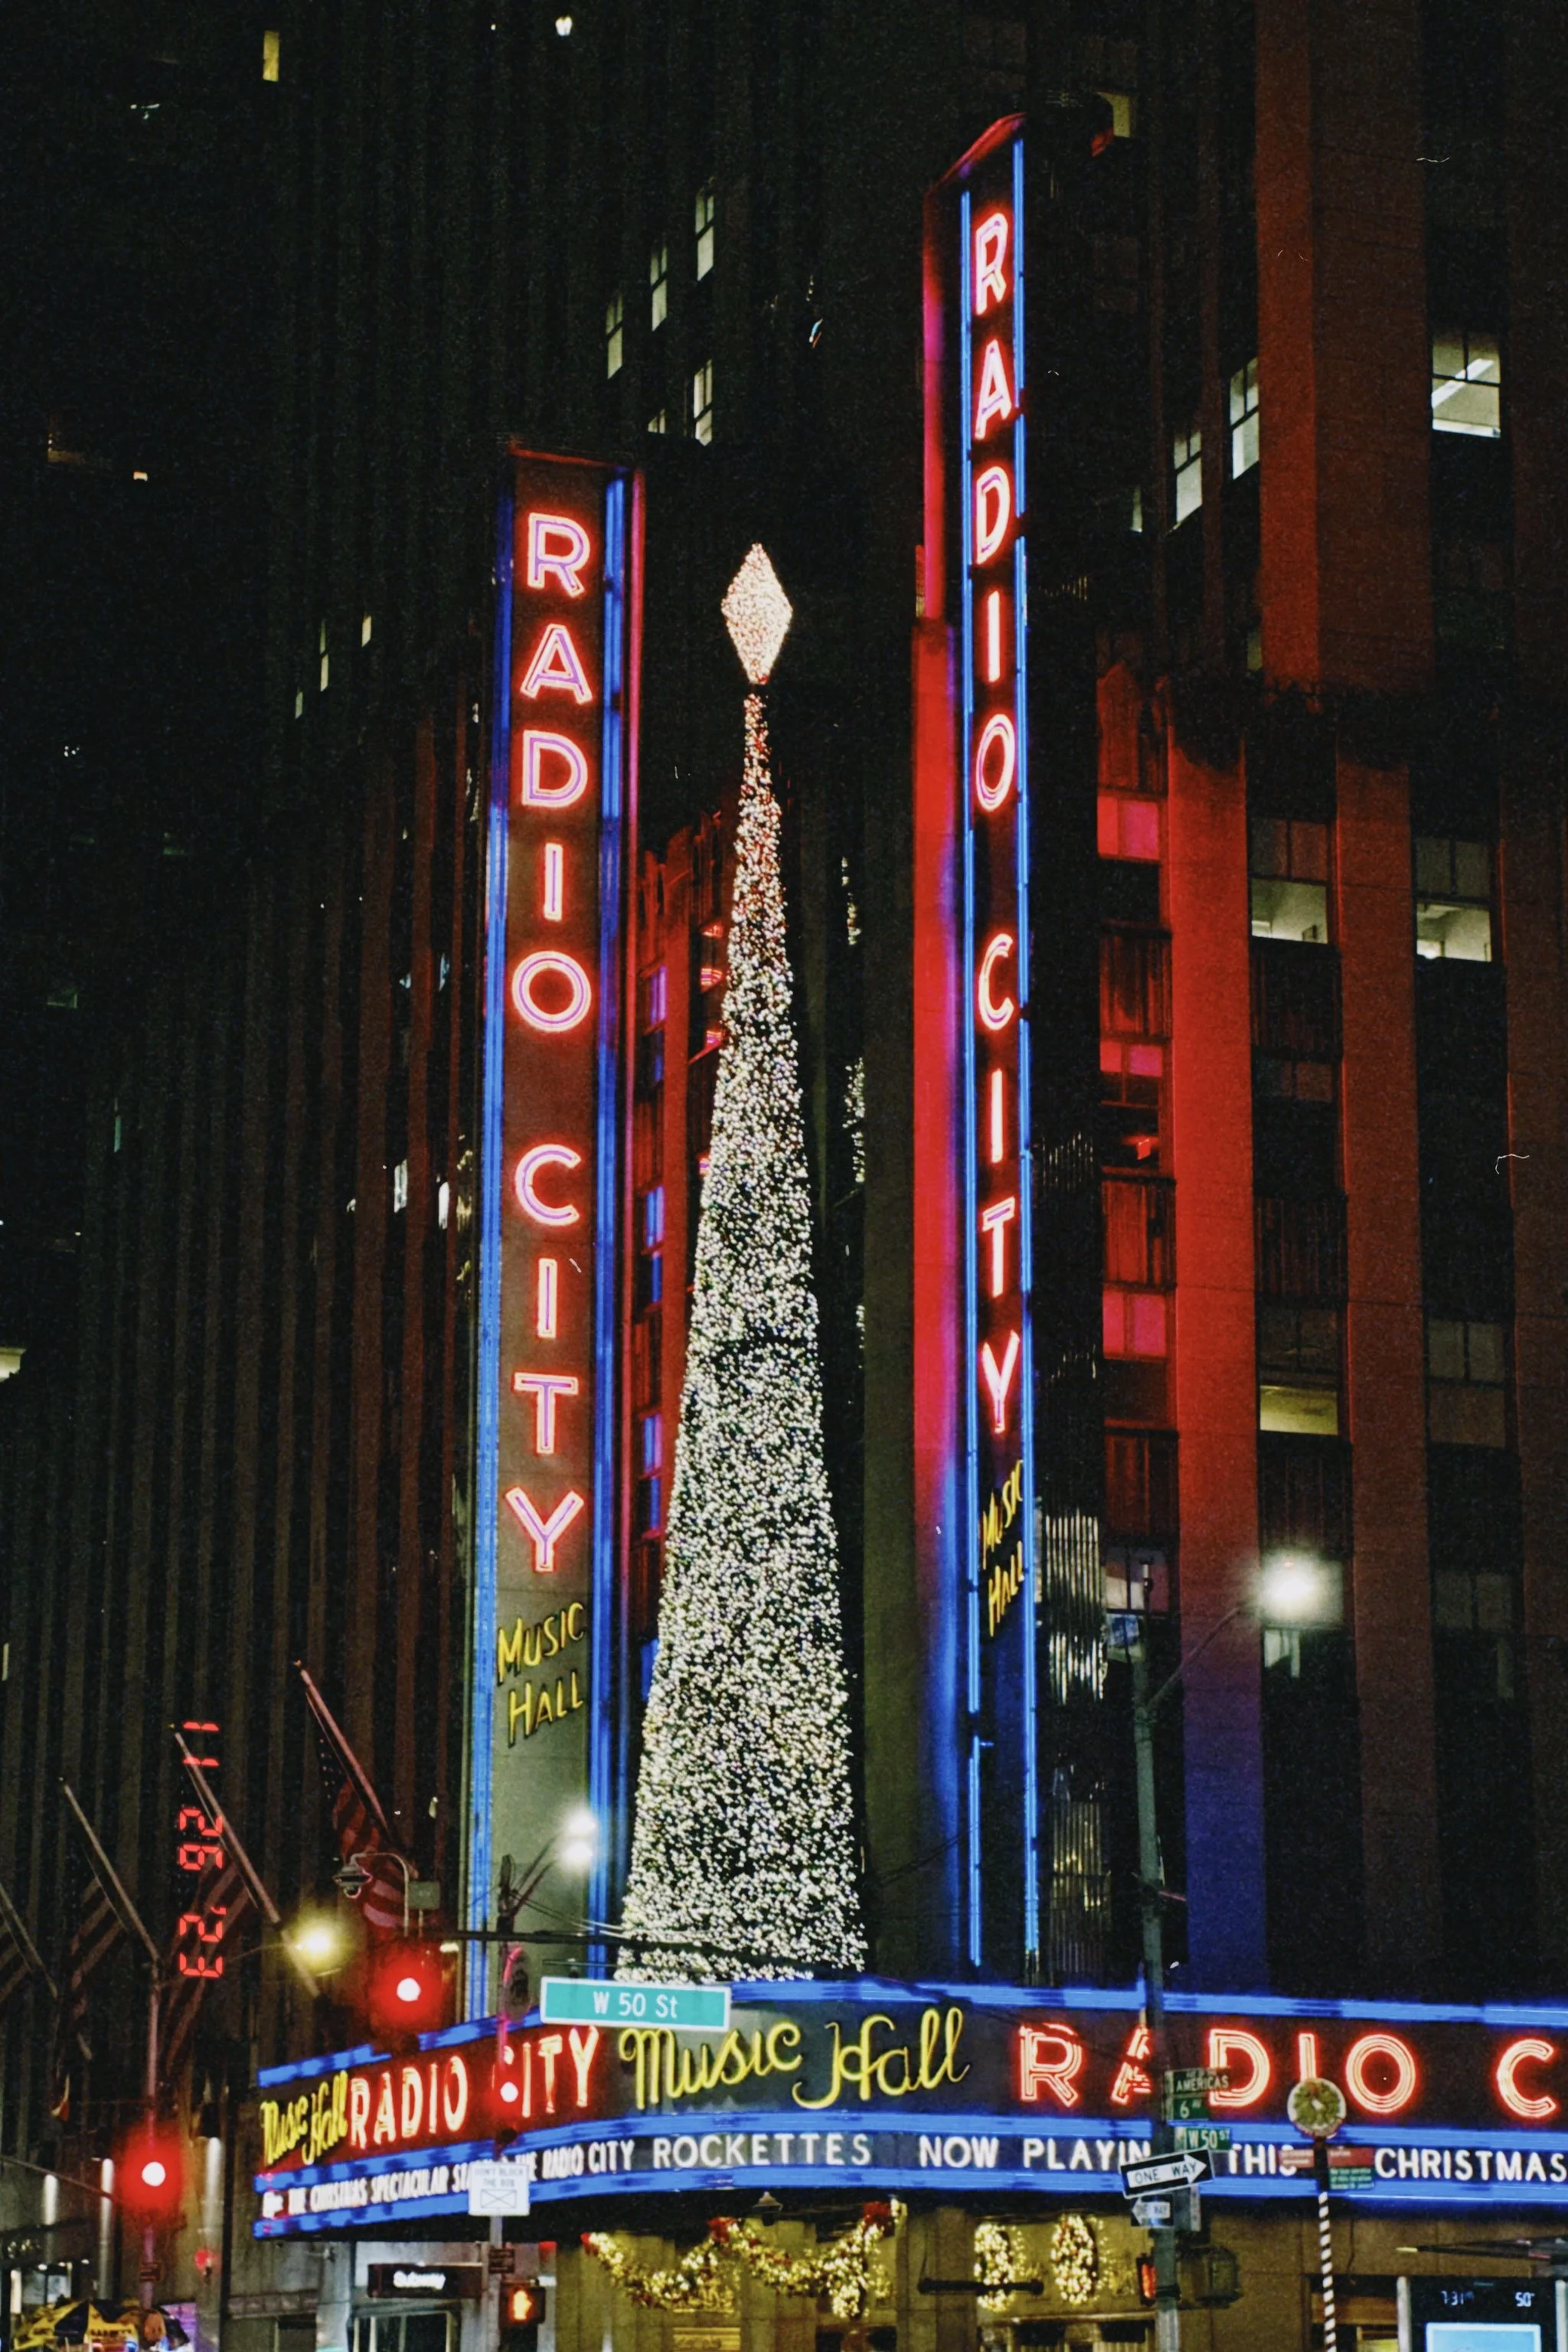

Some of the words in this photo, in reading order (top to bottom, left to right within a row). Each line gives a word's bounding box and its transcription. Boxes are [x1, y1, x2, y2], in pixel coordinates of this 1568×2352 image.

[975, 212, 1016, 812] RADIO
[511, 511, 593, 1032] RADIO
[978, 933, 1020, 1433] CITY
[505, 1142, 585, 1573] CITY
[508, 1671, 584, 1746] HALL
[593, 1991, 610, 2014] W
[618, 1992, 647, 2017] 50
[655, 1993, 678, 2019] St
[350, 2055, 469, 2150] RADIO
[492, 2025, 600, 2118] ITY
[618, 2020, 803, 2110] Music
[792, 2007, 970, 2110] Hall
[1176, 2075, 1230, 2092] AMERICAS
[260, 2096, 309, 2165] Music
[302, 2069, 348, 2166] Hall
[1180, 2100, 1190, 2119] 6
[1187, 2129, 1200, 2149] W
[1200, 2129, 1218, 2149] 50
[371, 2165, 450, 2204] SPECTACULAR
[541, 2145, 585, 2180] RADIO
[587, 2139, 635, 2174] CITY
[652, 2132, 871, 2170] ROCKETTES
[919, 2137, 999, 2167] NOW
[1022, 2137, 1152, 2171] PLAYIN
[1374, 2147, 1568, 2183] CHRISTMAS
[1134, 2168, 1161, 2184] ONE
[1171, 2161, 1197, 2177] WAY
